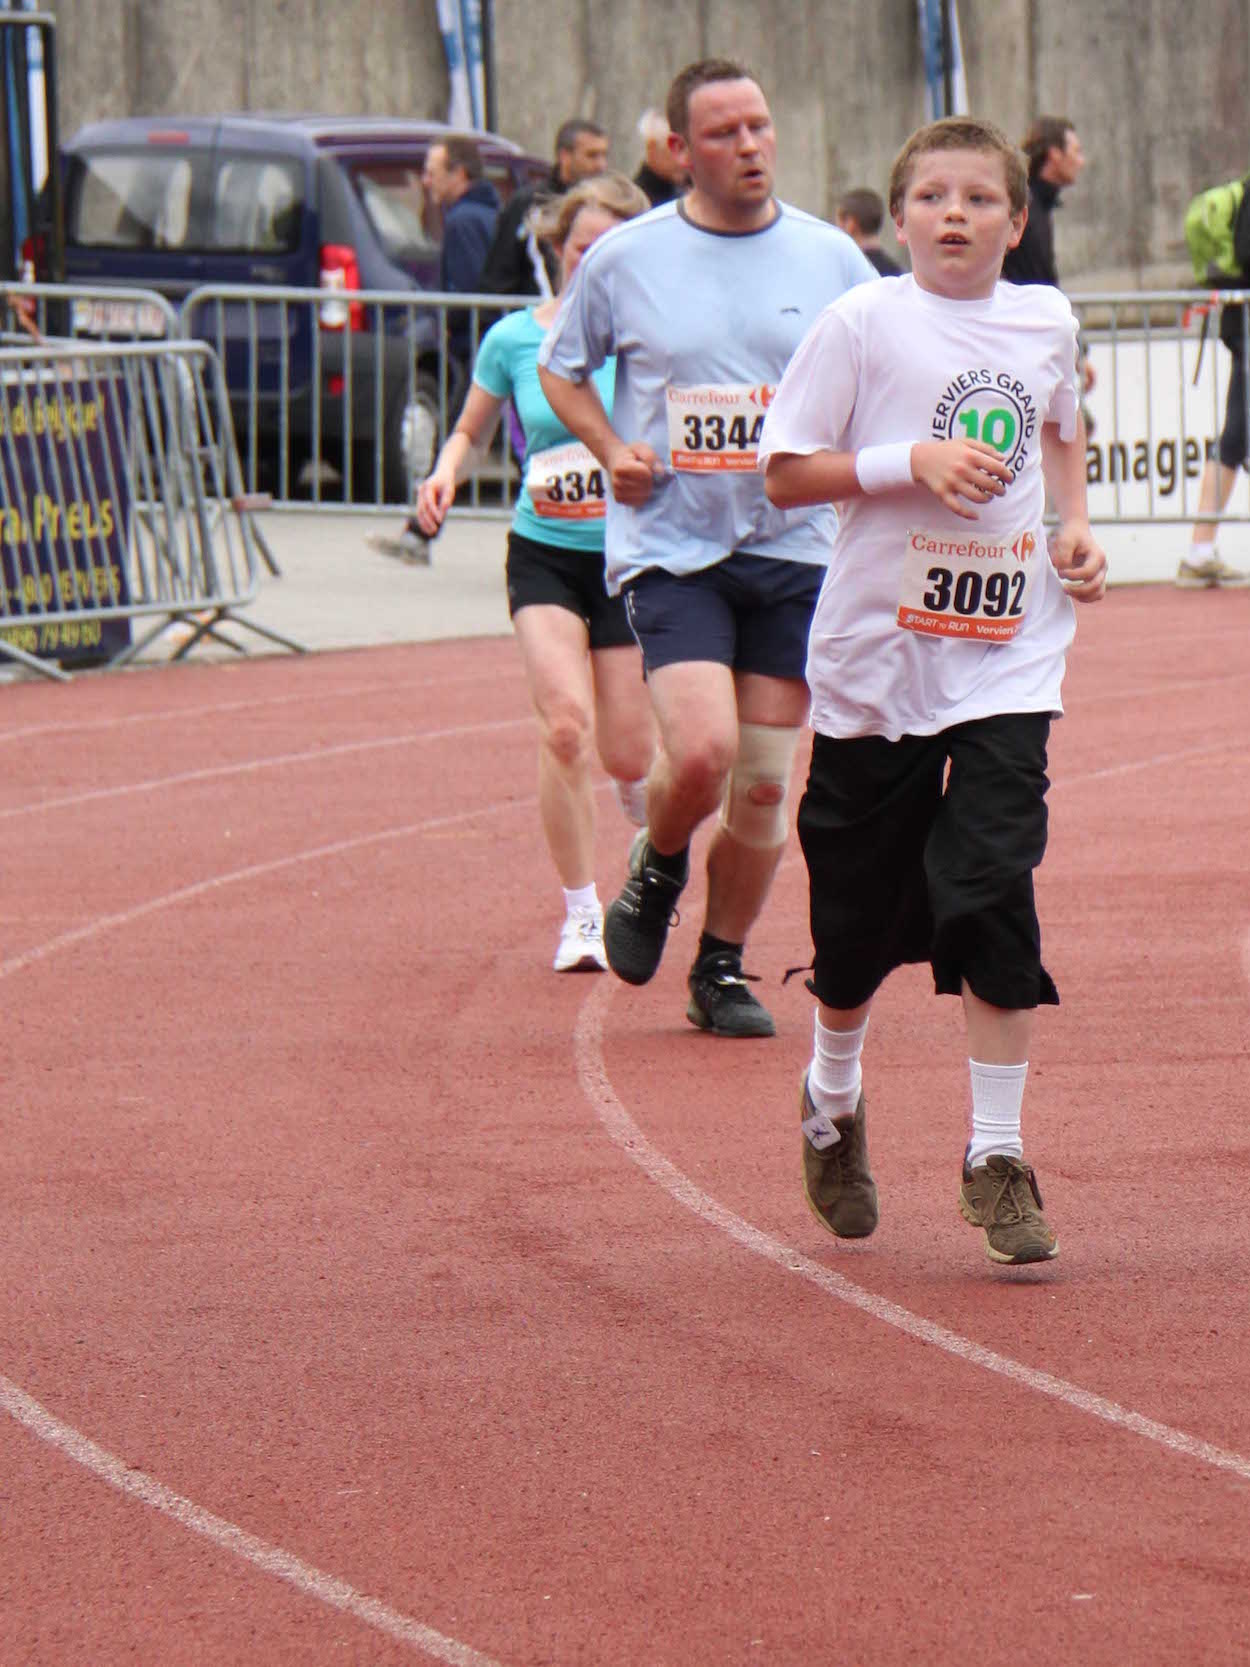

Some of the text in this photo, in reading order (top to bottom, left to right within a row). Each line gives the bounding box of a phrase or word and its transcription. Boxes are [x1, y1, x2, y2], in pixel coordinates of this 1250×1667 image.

[997, 373, 1036, 439] GRAND
[683, 415, 766, 450] 3344
[958, 407, 1016, 453] 10
[545, 468, 606, 503] 334
[911, 533, 1007, 559] Carrefour
[923, 567, 1026, 617] 3092
[906, 613, 938, 628] START
